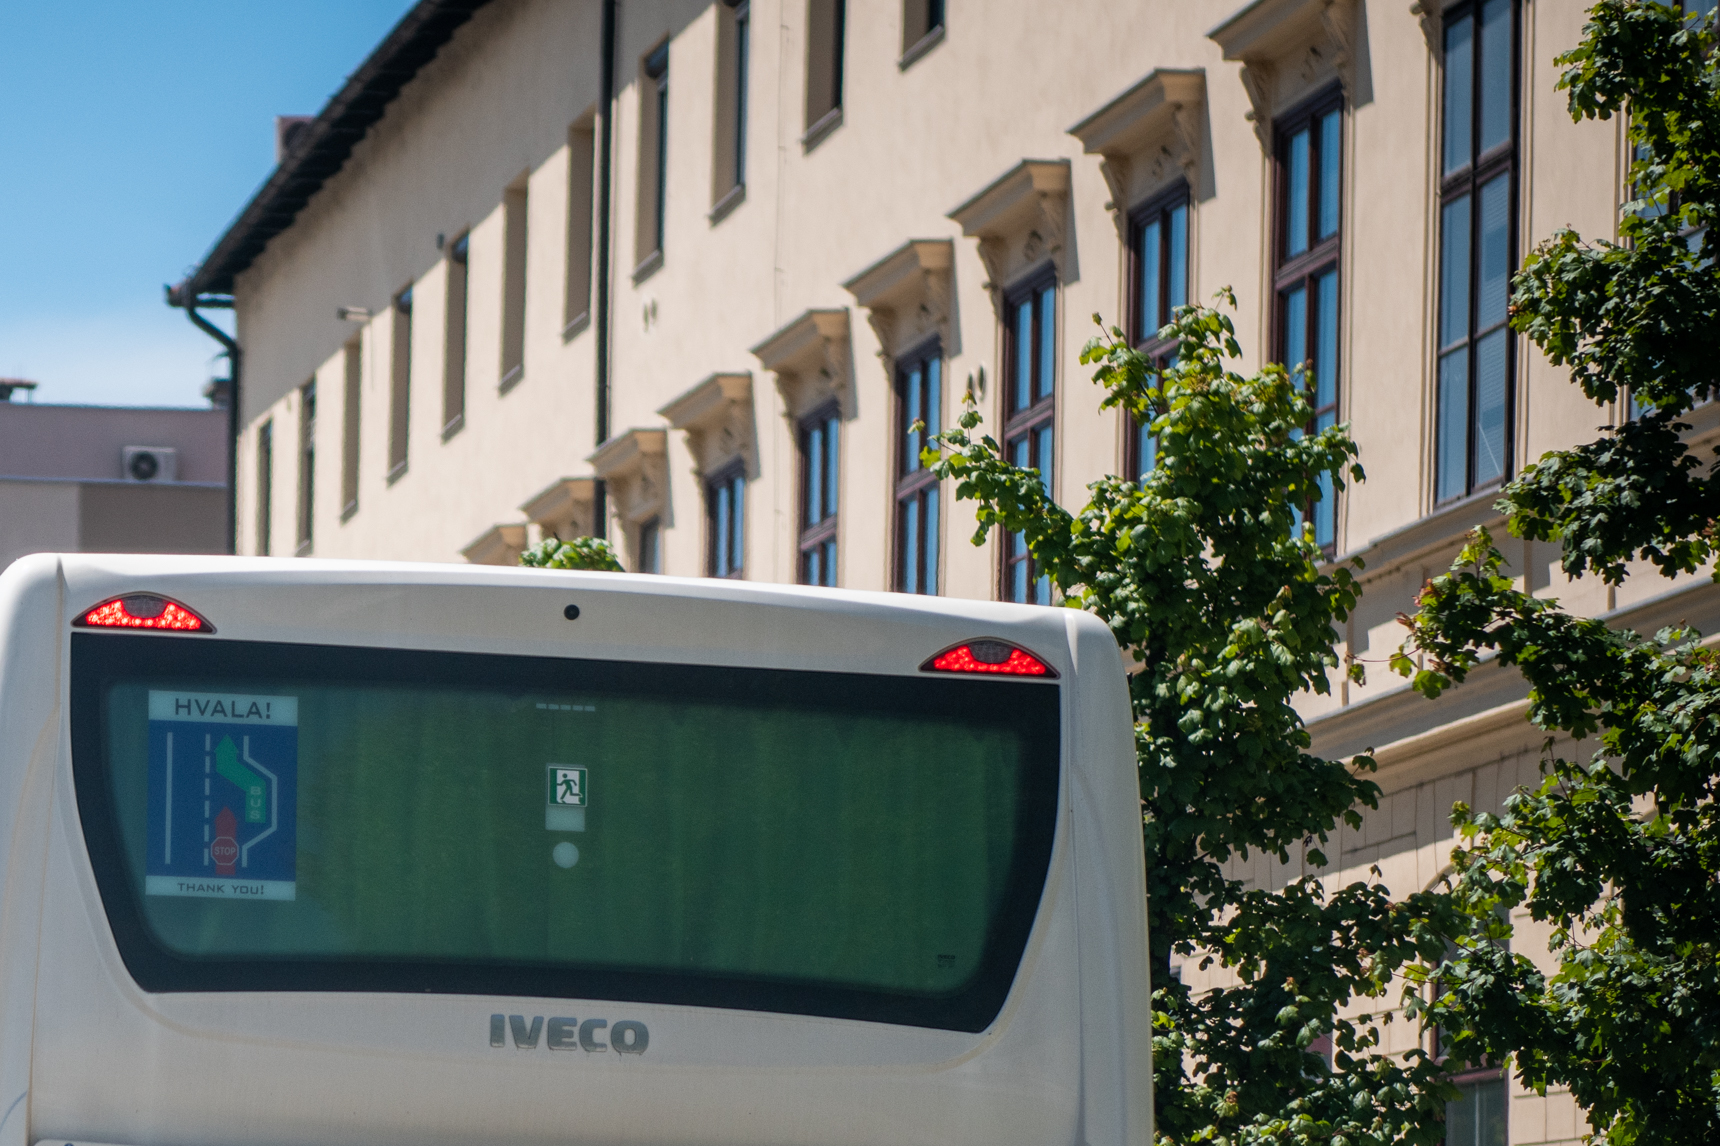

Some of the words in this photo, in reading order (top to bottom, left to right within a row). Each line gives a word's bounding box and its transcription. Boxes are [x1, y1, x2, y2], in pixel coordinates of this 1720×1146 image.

[174, 698, 272, 719] HVALA!
[249, 785, 262, 820] BUS
[213, 845, 237, 856] STOP
[177, 882, 225, 893] THANK
[231, 884, 265, 895] YOU!
[490, 1013, 650, 1054] IVECO
